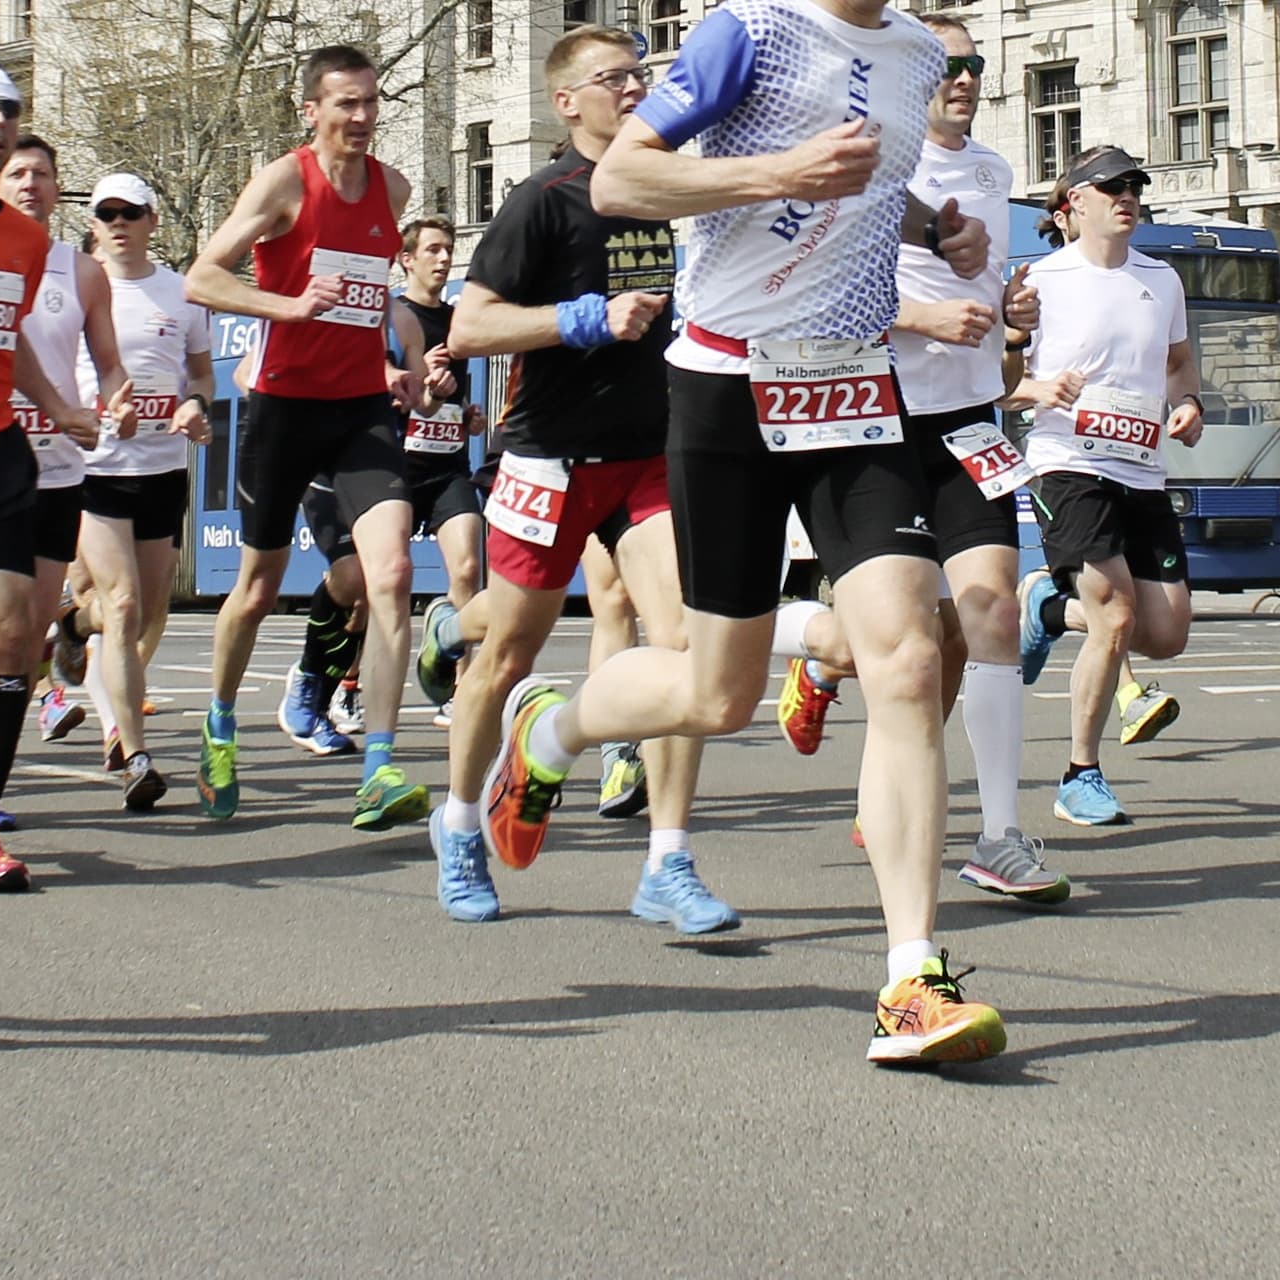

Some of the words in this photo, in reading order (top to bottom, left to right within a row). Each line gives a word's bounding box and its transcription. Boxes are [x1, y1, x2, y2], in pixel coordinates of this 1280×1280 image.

[337, 283, 385, 309] 886
[775, 363, 864, 379] Halbmarathon
[765, 380, 883, 421] 22722
[1111, 404, 1142, 417] Thomas
[412, 420, 461, 441] 21342
[1083, 412, 1156, 446] 20997
[203, 524, 233, 548] Nah
